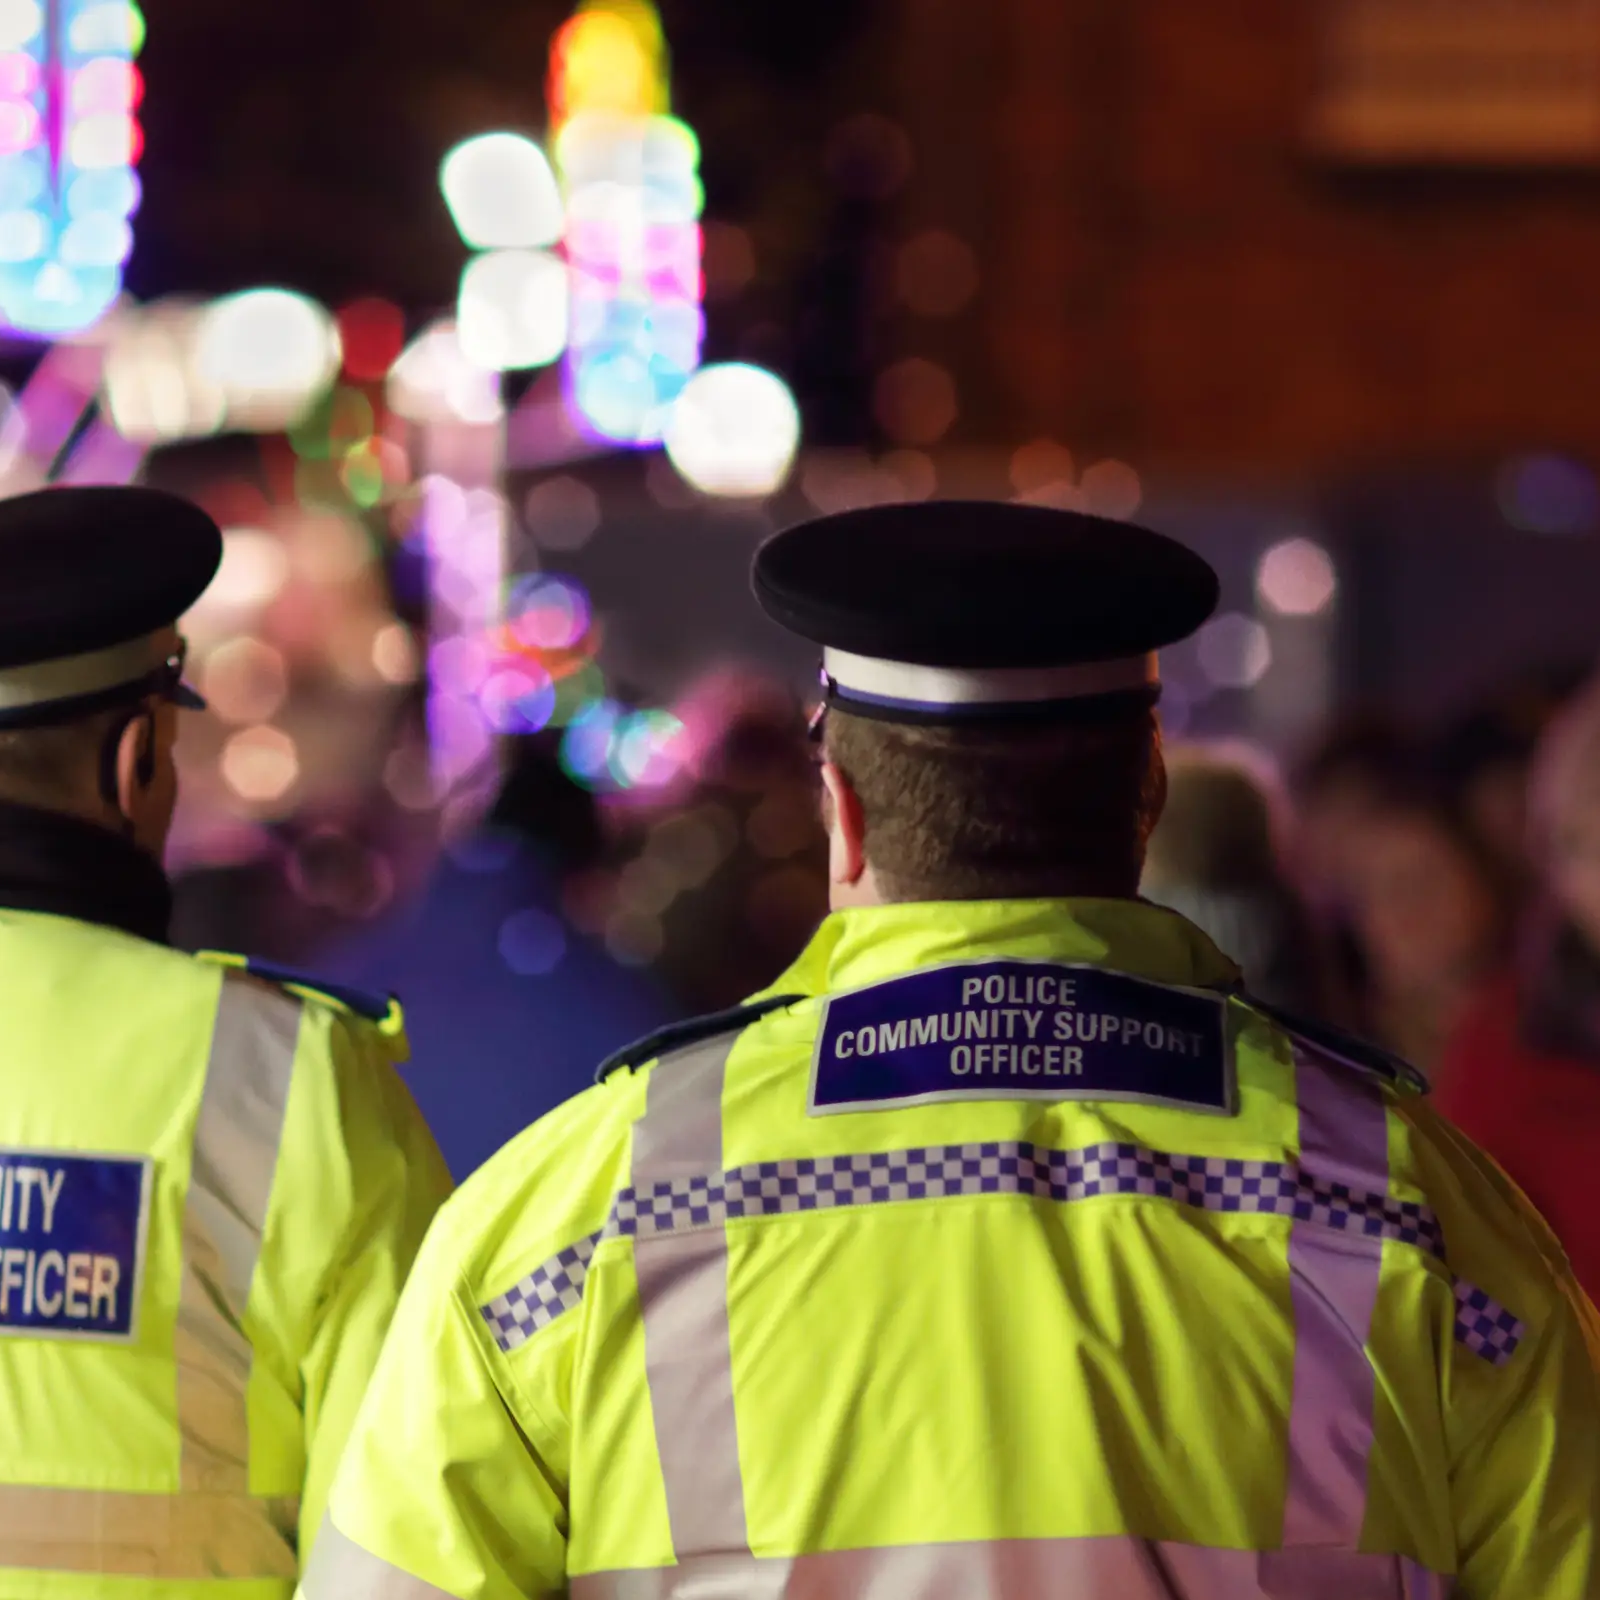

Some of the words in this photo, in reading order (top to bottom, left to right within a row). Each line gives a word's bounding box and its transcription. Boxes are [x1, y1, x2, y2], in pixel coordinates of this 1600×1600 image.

[961, 974, 1077, 1006] POLICE
[835, 1008, 1042, 1059] COMMUNITY
[1053, 1007, 1204, 1057] SUPPORT
[950, 1044, 1083, 1075] OFFICER
